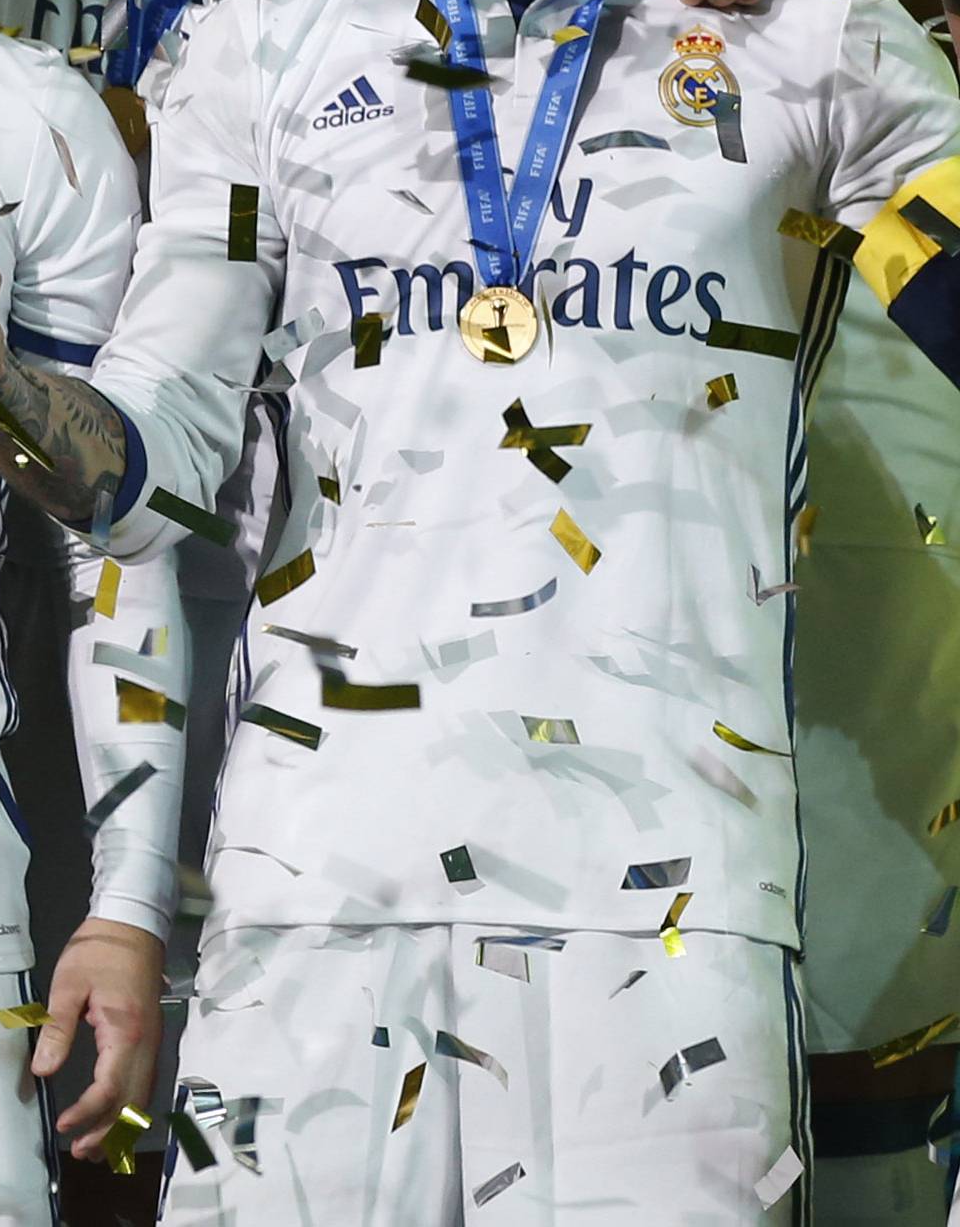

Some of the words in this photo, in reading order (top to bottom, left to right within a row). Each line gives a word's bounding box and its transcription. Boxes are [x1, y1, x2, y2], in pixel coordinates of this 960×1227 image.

[453, 41, 469, 63] IFA
[560, 43, 579, 73] FIFA
[312, 103, 395, 131] adidas
[462, 89, 477, 119] FIFA
[544, 92, 563, 125] FIFA
[470, 138, 485, 170] FIFA
[529, 144, 548, 177] FIFA
[478, 189, 494, 222] FIFA
[513, 196, 534, 229] FIFA
[332, 246, 726, 342] Emrates
